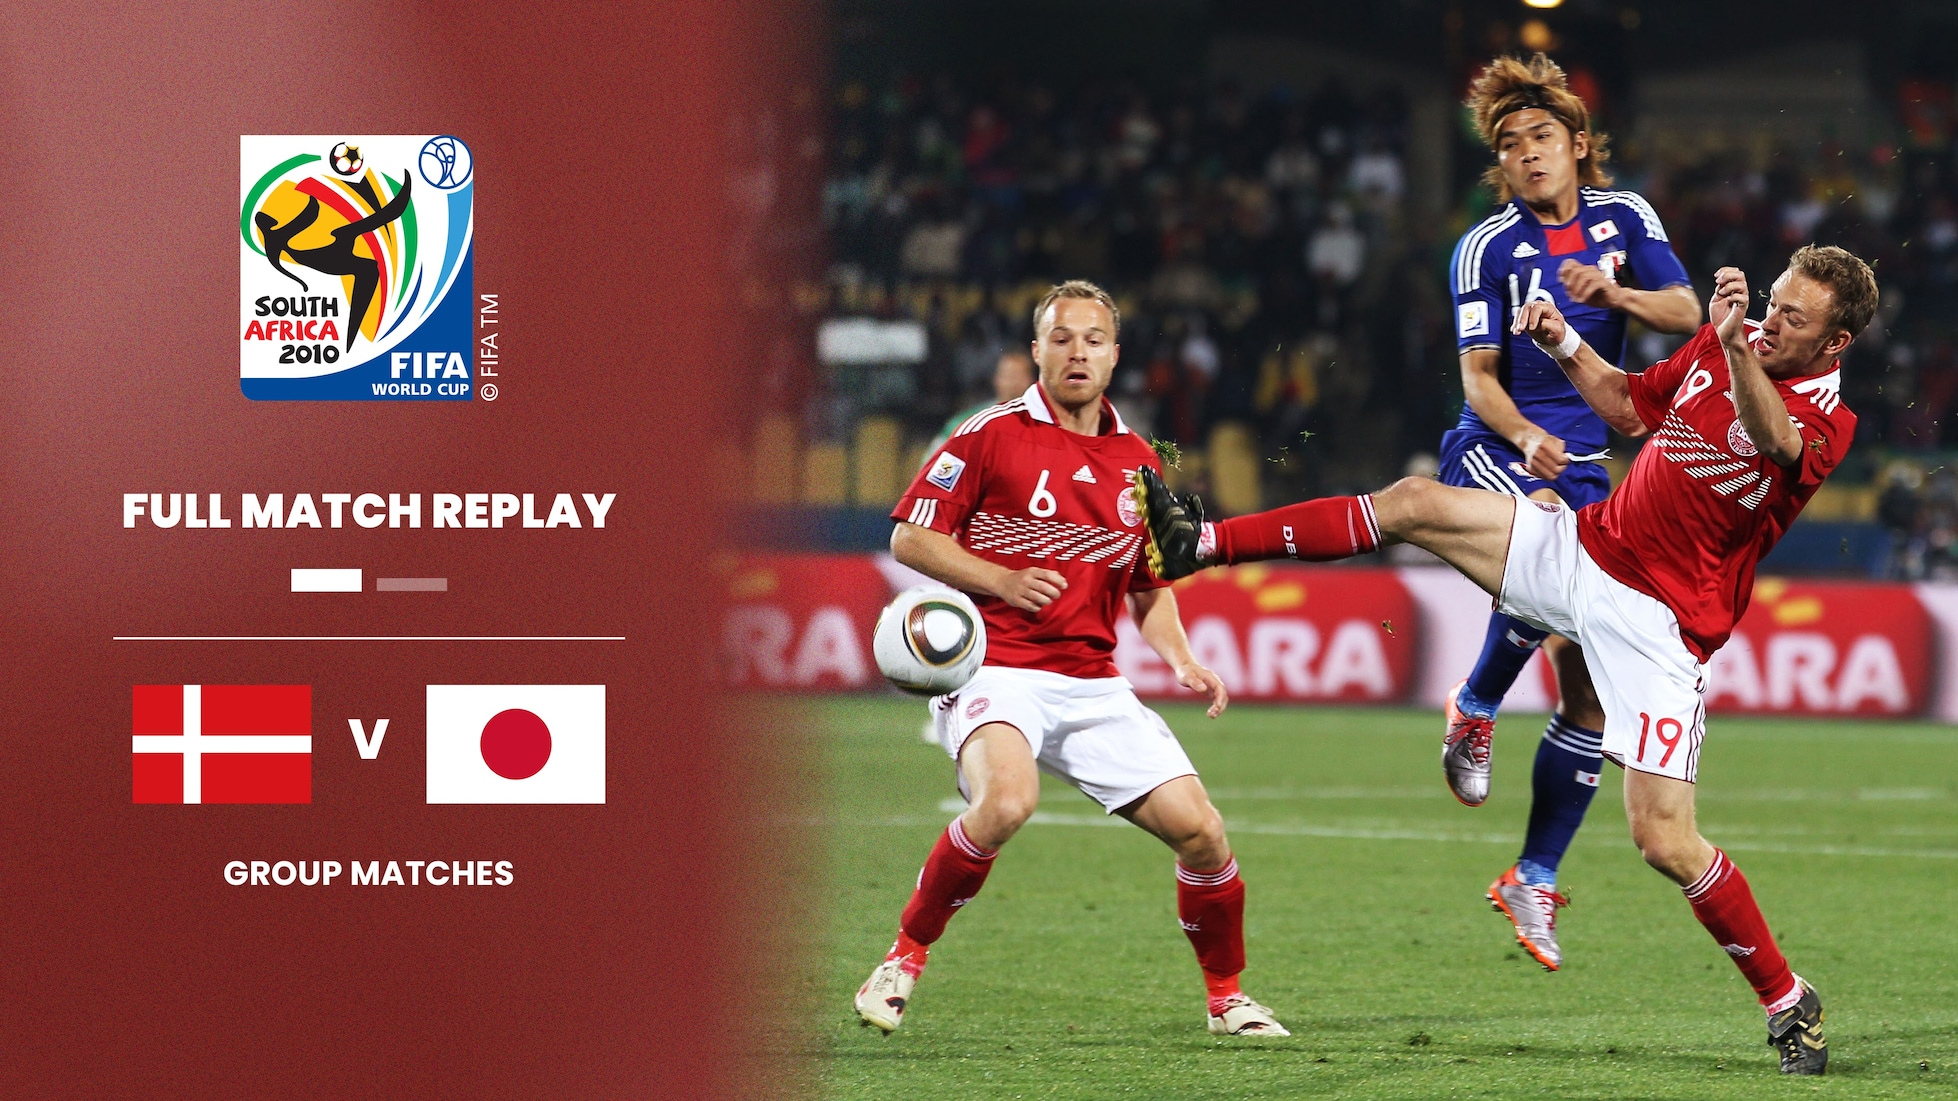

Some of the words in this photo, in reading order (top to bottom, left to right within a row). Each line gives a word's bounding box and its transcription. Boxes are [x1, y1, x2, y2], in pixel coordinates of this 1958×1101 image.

[1672, 359, 1713, 409] 19
[1028, 469, 1057, 518] 6
[1282, 525, 1298, 559] DB
[1637, 712, 1683, 768] 19
